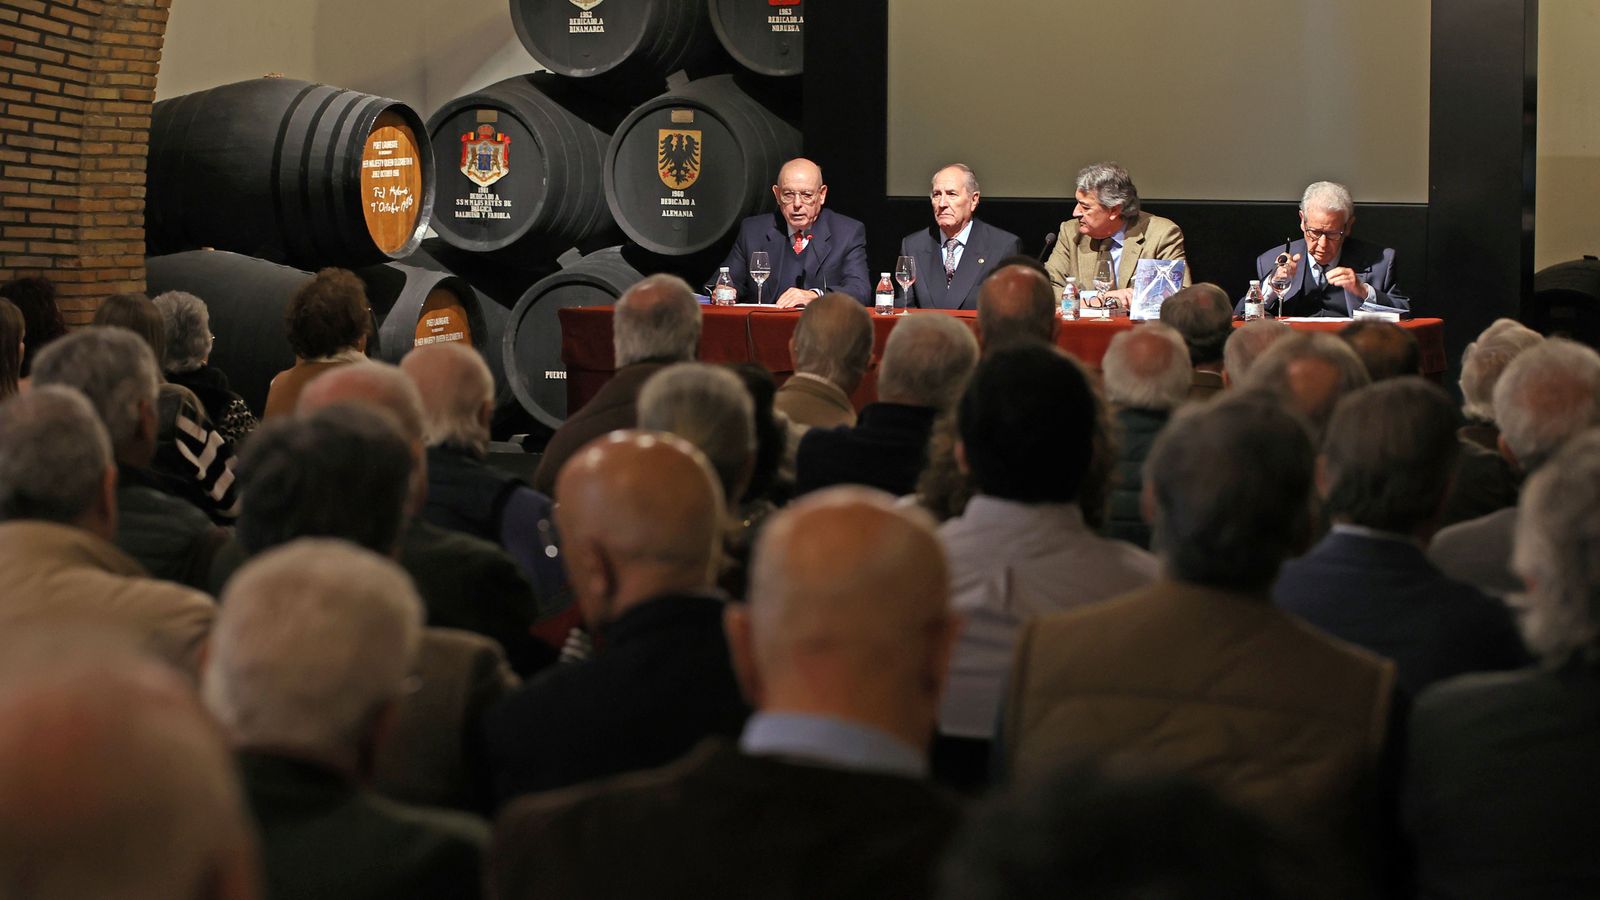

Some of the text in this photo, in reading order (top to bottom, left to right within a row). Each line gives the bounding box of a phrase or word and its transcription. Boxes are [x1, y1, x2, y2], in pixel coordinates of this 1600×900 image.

[569, 17, 598, 25] DEDICADO
[569, 25, 605, 33] DINAMARCA
[771, 24, 800, 32] NORUEGA
[660, 197, 696, 206] DEDICADO A
[661, 209, 694, 218] ALEMANIA
[545, 370, 567, 379] PUERTO
